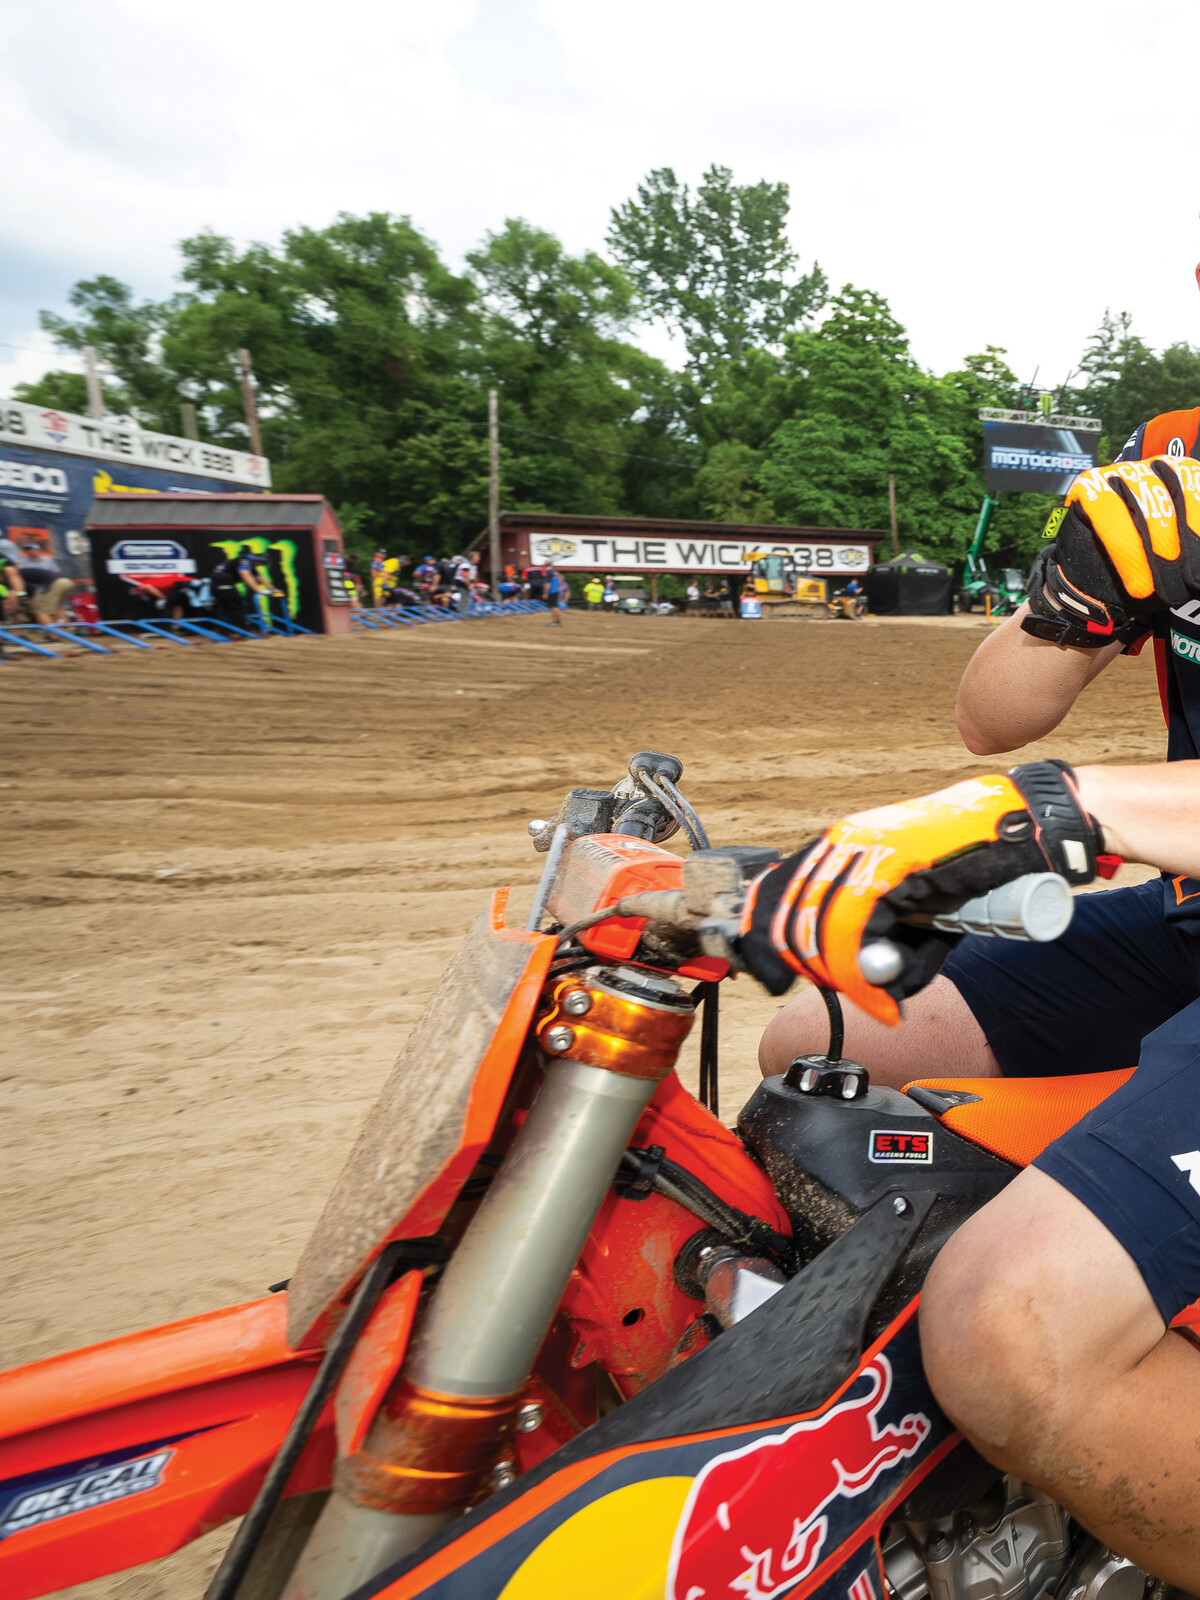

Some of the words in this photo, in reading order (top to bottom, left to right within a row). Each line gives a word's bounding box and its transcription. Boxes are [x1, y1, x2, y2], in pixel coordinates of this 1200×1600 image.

[80, 424, 133, 455] THE
[140, 436, 196, 466] WICK
[991, 451, 1093, 470] MOTOCROSS
[581, 539, 667, 564] THE
[876, 1135, 927, 1152] ETS
